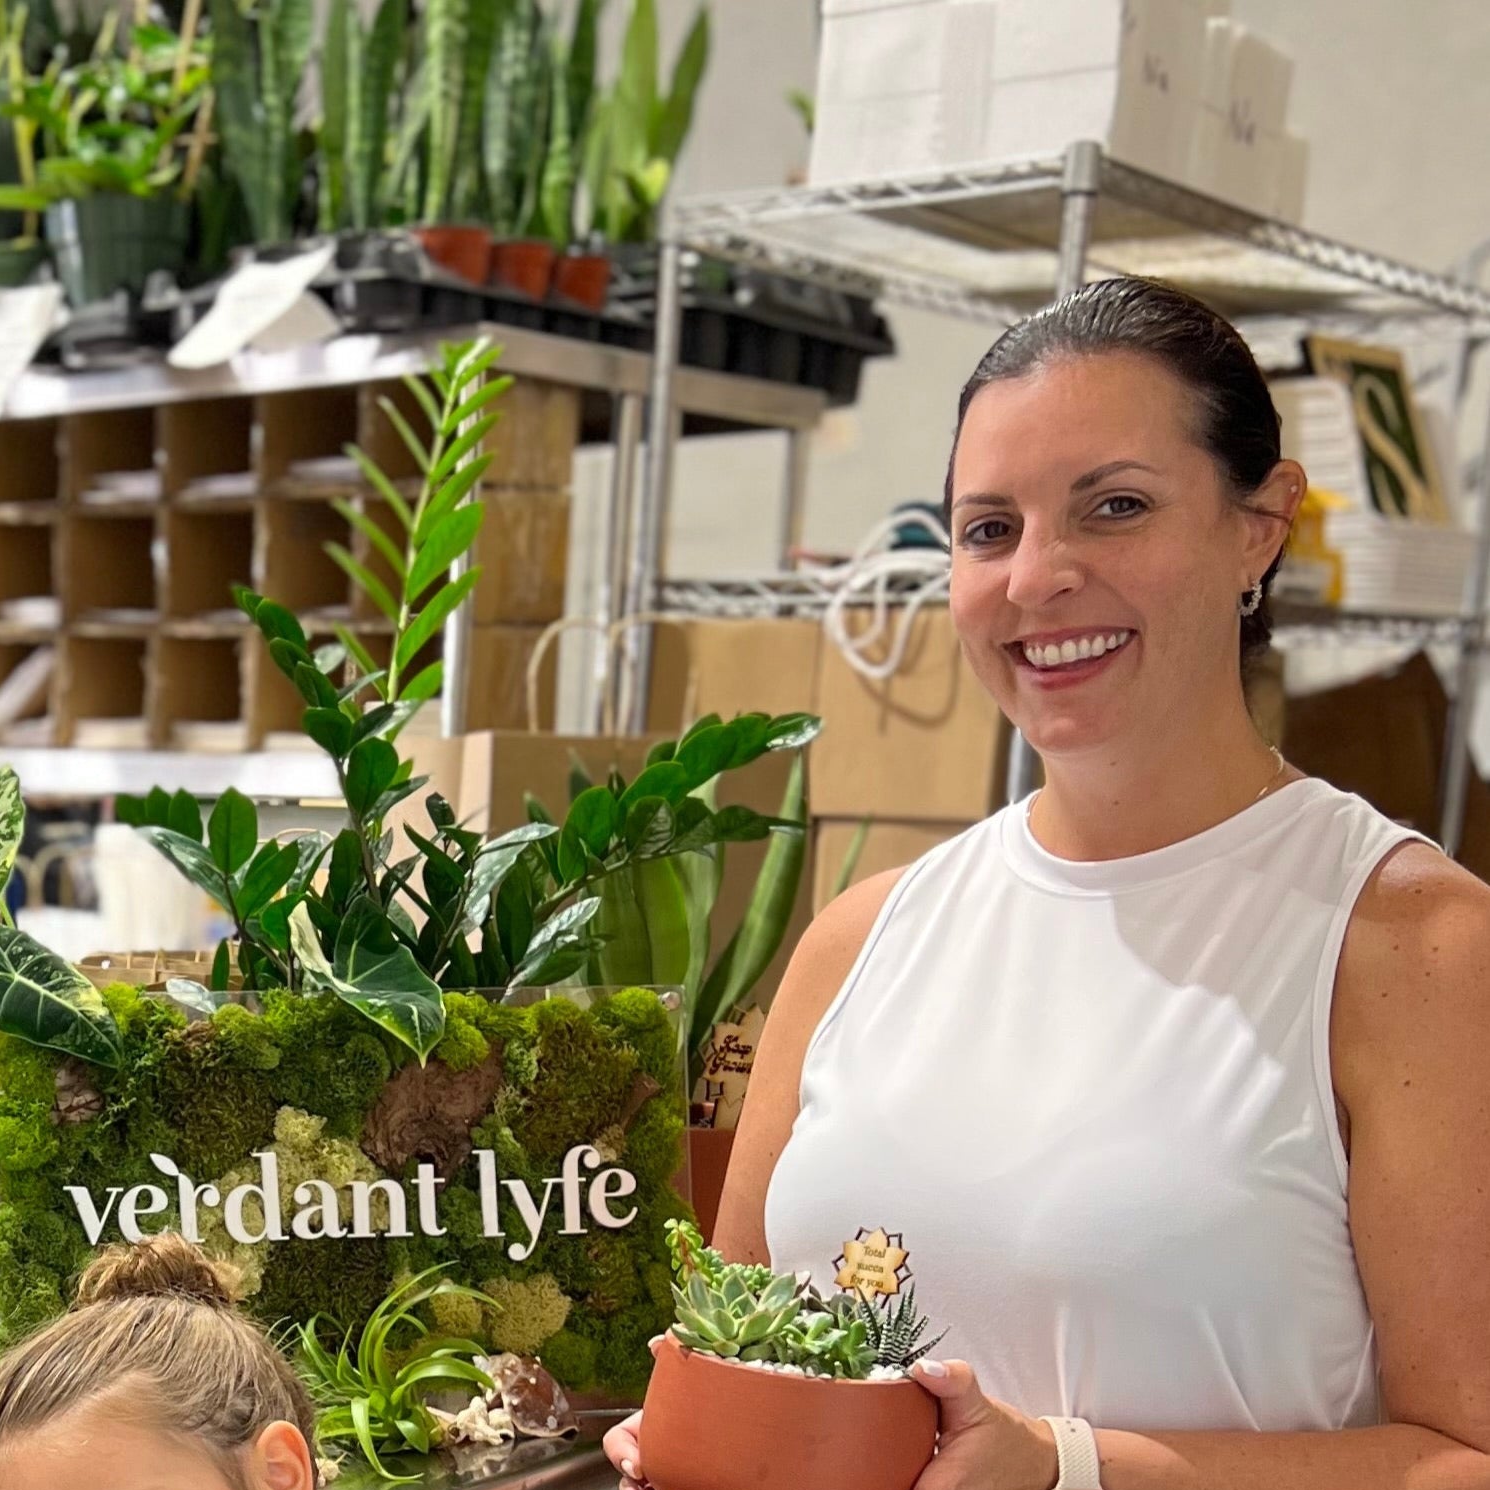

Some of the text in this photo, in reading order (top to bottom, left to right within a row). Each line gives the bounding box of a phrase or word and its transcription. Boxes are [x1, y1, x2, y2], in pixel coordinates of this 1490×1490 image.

[62, 1143, 639, 1262] verdant lyfe
[863, 1245, 887, 1259] Total
[849, 1273, 884, 1289] for you
